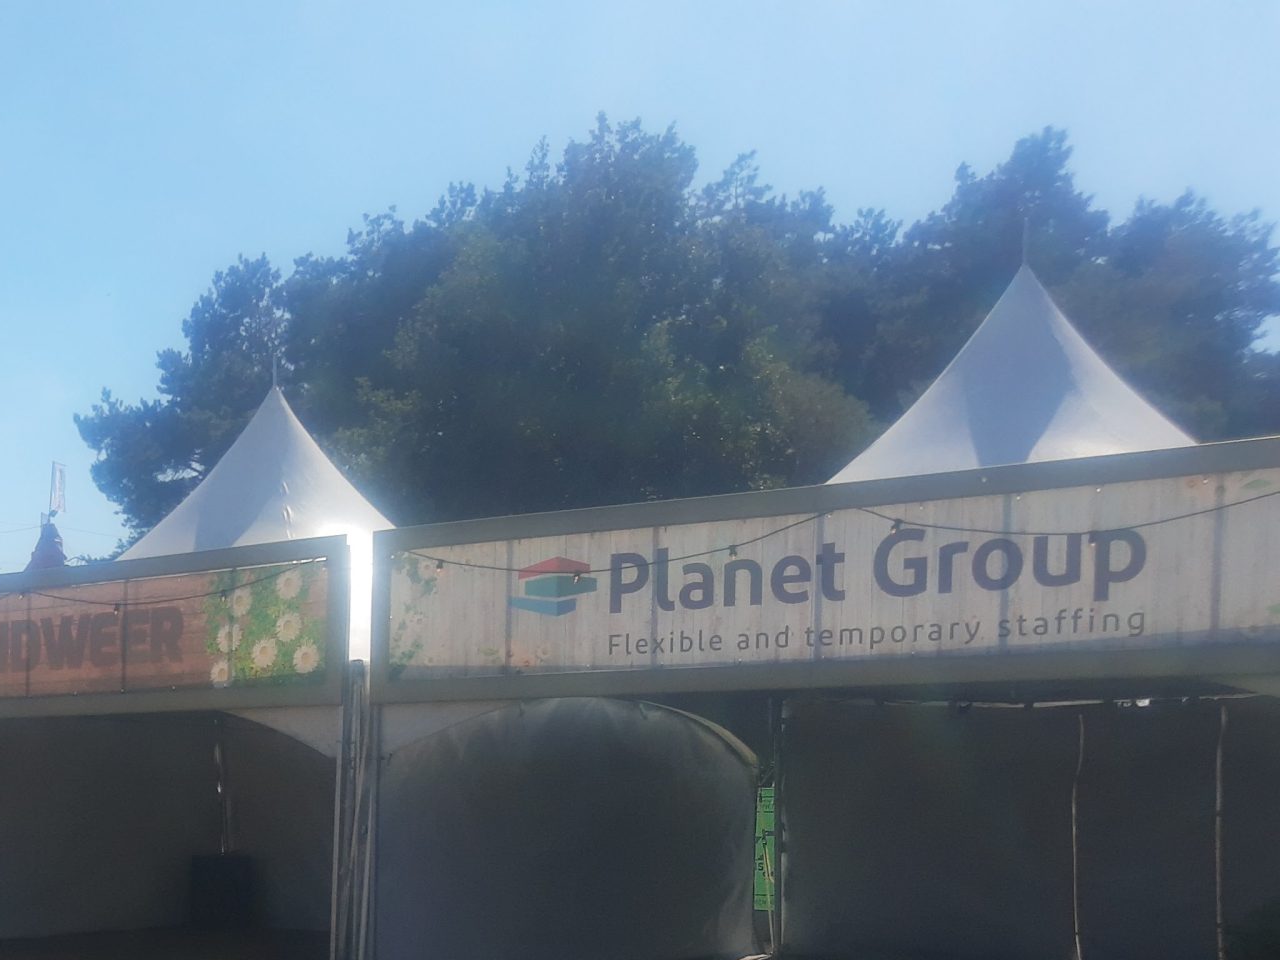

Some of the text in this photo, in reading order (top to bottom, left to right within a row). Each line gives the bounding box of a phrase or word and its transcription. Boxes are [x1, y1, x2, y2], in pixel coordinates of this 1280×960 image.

[609, 528, 1148, 614] Planet Group
[608, 607, 1146, 656] Flexible and temporary staffing
